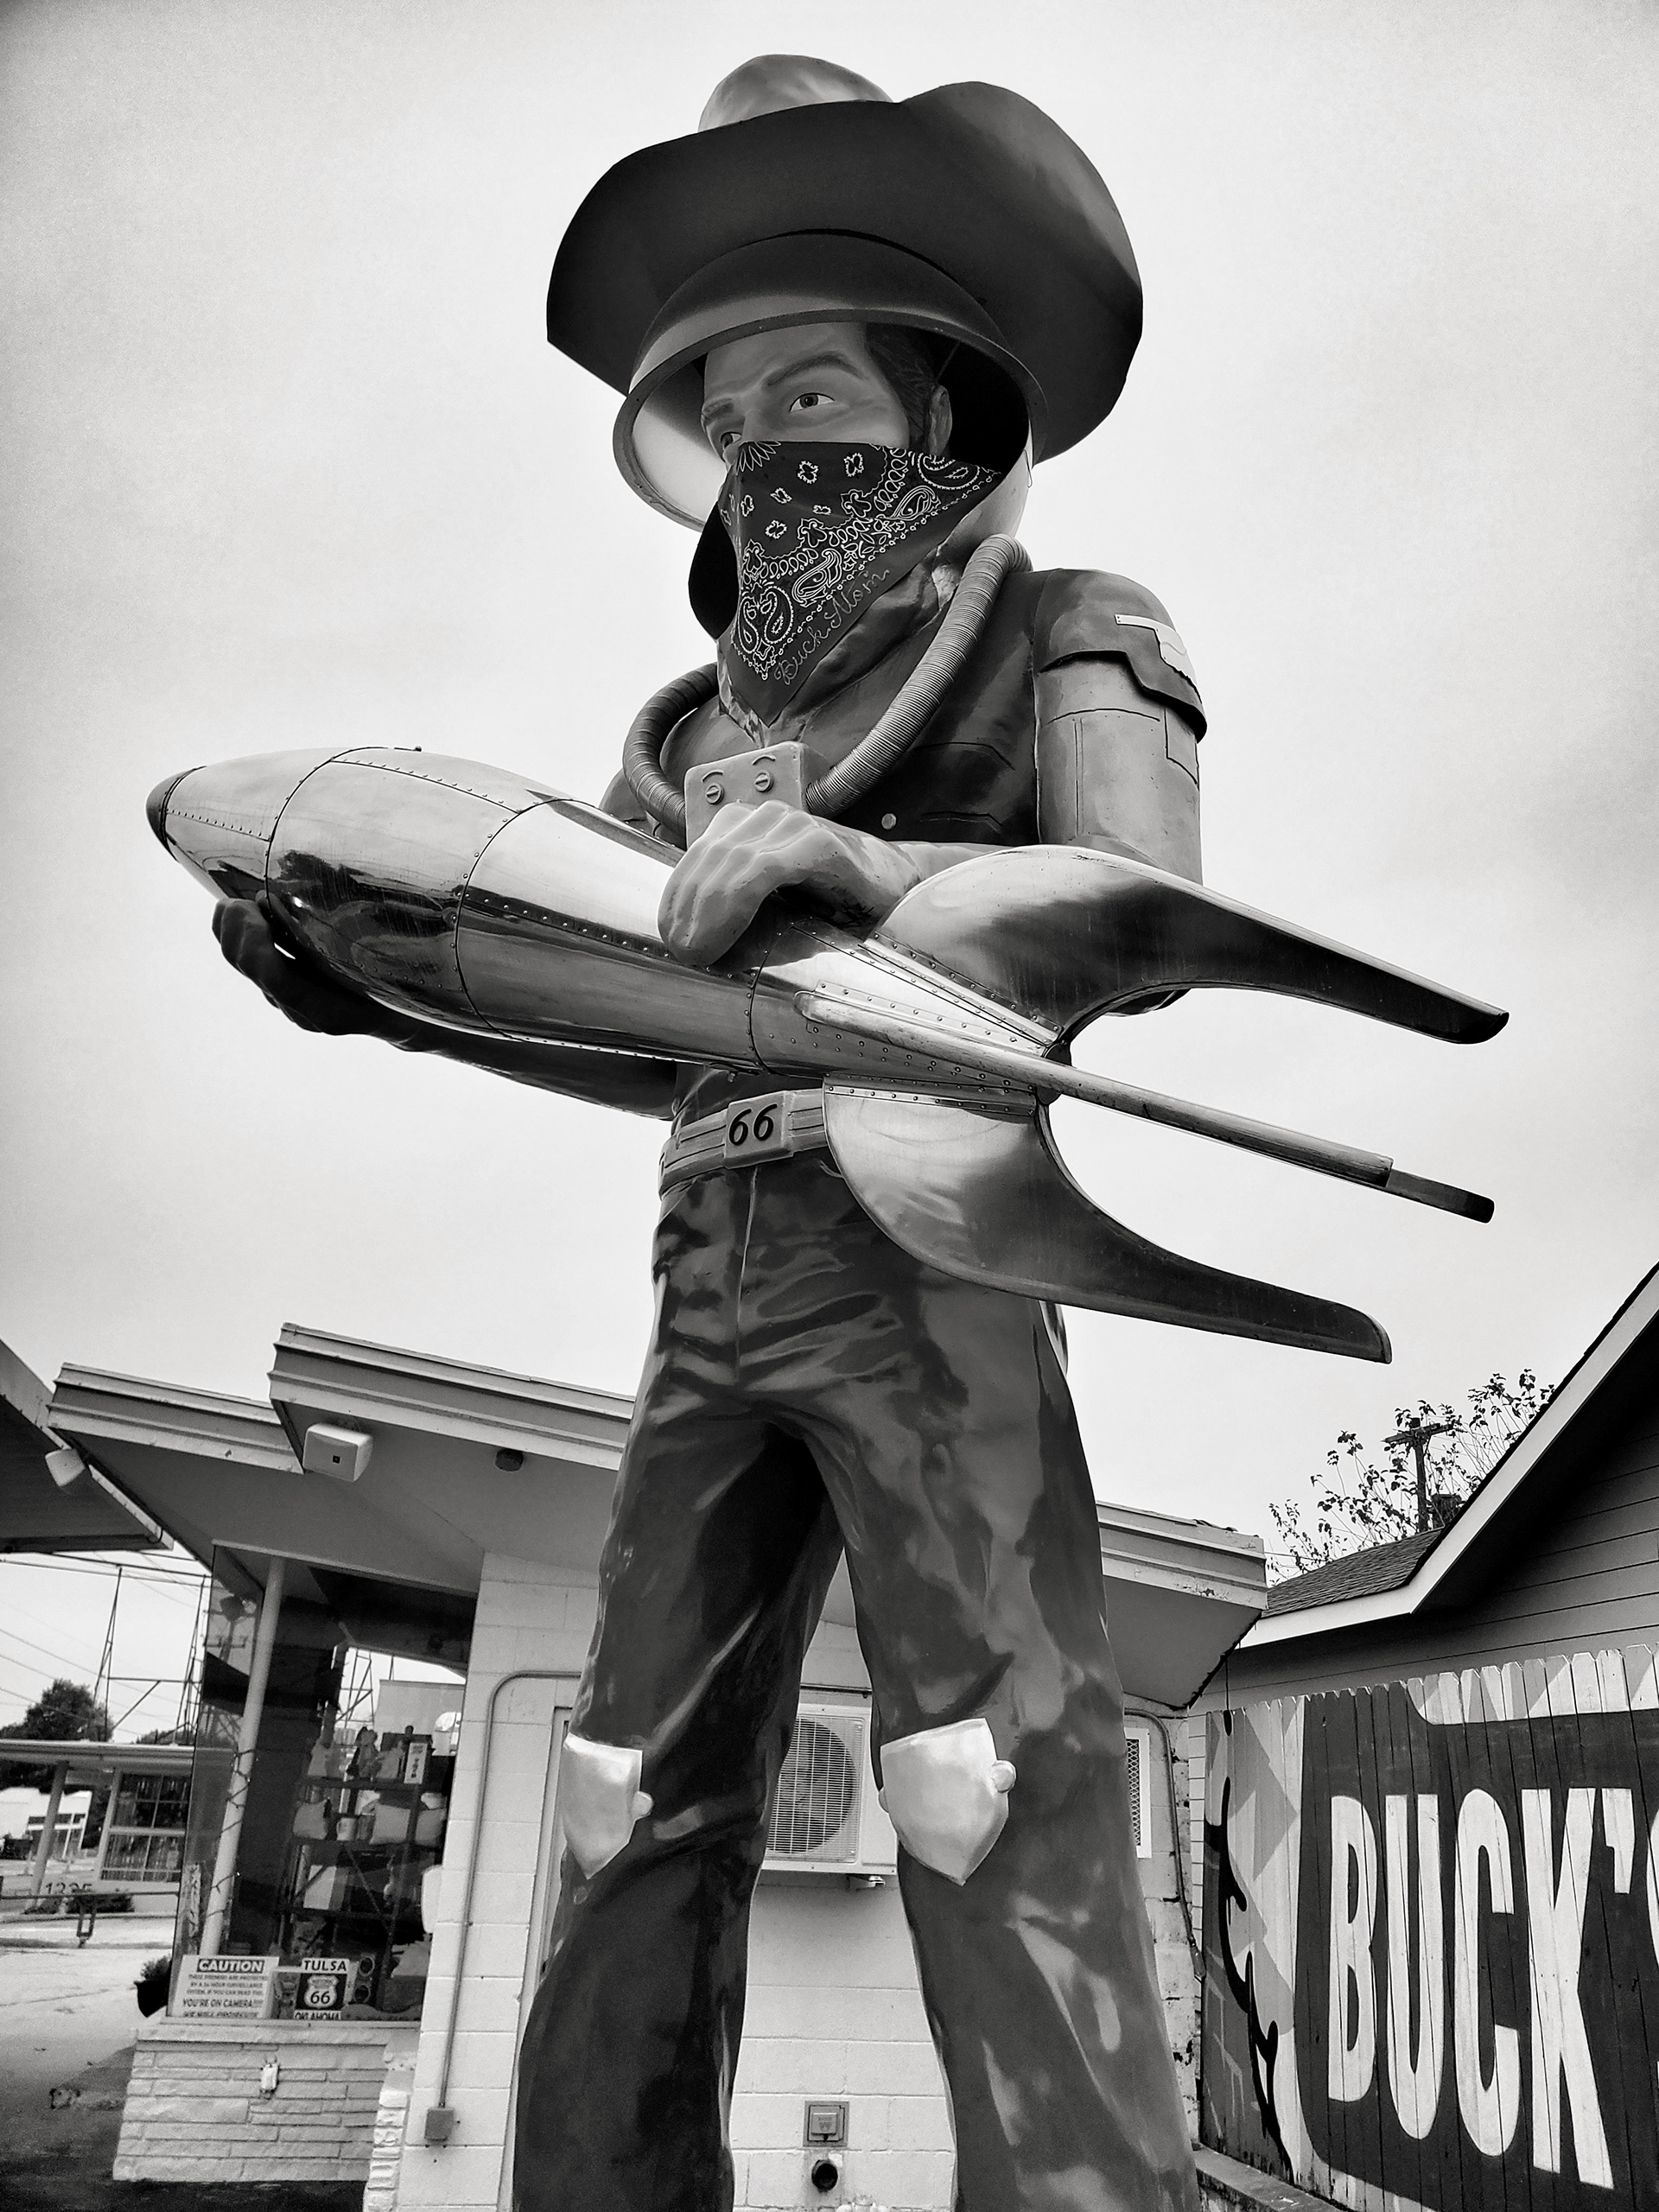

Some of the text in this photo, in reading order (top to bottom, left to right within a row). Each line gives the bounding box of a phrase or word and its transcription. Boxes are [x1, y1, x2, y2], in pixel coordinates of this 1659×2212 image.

[774, 626, 831, 684] Buck
[728, 1103, 778, 1146] 66
[199, 1960, 263, 1973] CAUTION
[304, 1960, 347, 1972] TULSA
[183, 1998, 209, 2007] YOU'RE
[210, 1999, 222, 2007] ON
[310, 1990, 330, 2004] 66
